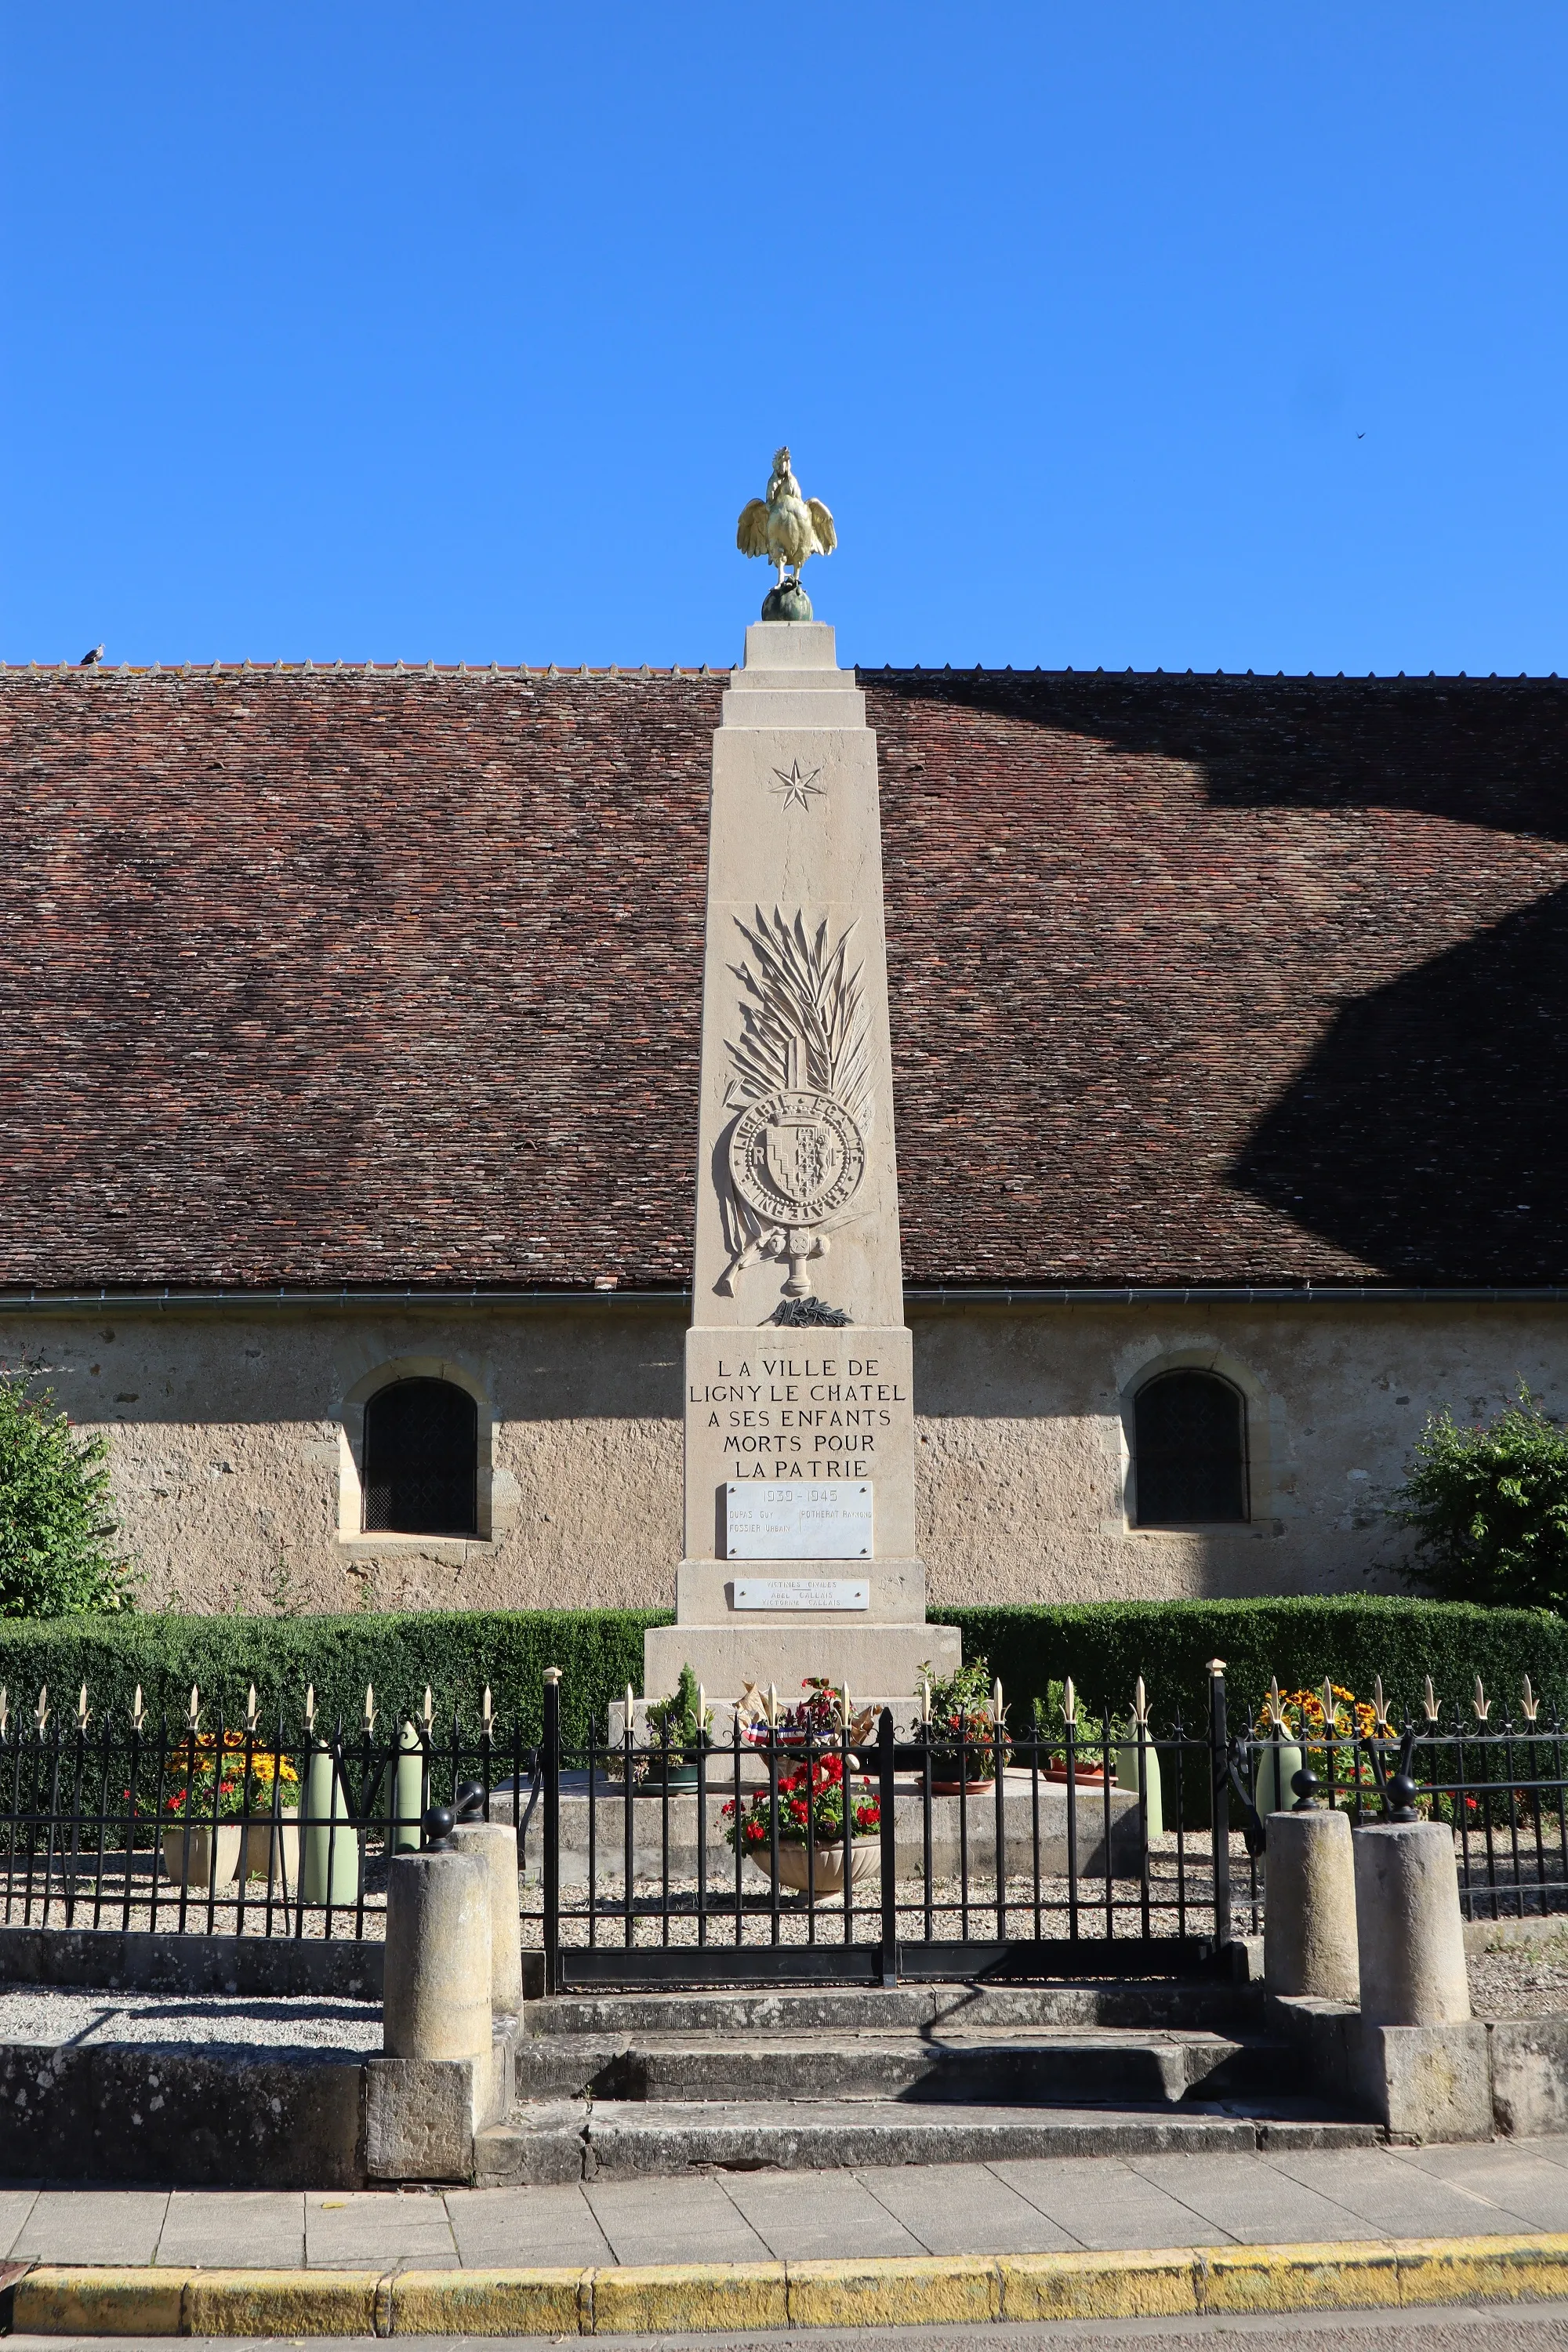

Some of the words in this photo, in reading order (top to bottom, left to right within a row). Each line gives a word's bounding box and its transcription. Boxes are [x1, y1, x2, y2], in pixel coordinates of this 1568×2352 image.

[734, 1094, 789, 1149] LIBERTE
[753, 1147, 764, 1164] R
[831, 1148, 843, 1166] F
[718, 1361, 751, 1376] LA
[762, 1360, 837, 1376] VILLE
[848, 1360, 879, 1375] DE
[690, 1386, 762, 1402] LIGNY
[771, 1386, 798, 1401] LE
[811, 1385, 906, 1402] CHATEL
[709, 1411, 720, 1427] A
[731, 1411, 770, 1427] SES
[782, 1410, 891, 1426] ENFANTS
[723, 1436, 801, 1452] MORTS
[815, 1436, 875, 1452] POUR
[736, 1461, 765, 1477] LA
[775, 1461, 867, 1477] PATRIE
[763, 1490, 793, 1502] 1939
[807, 1490, 837, 1501] 1945
